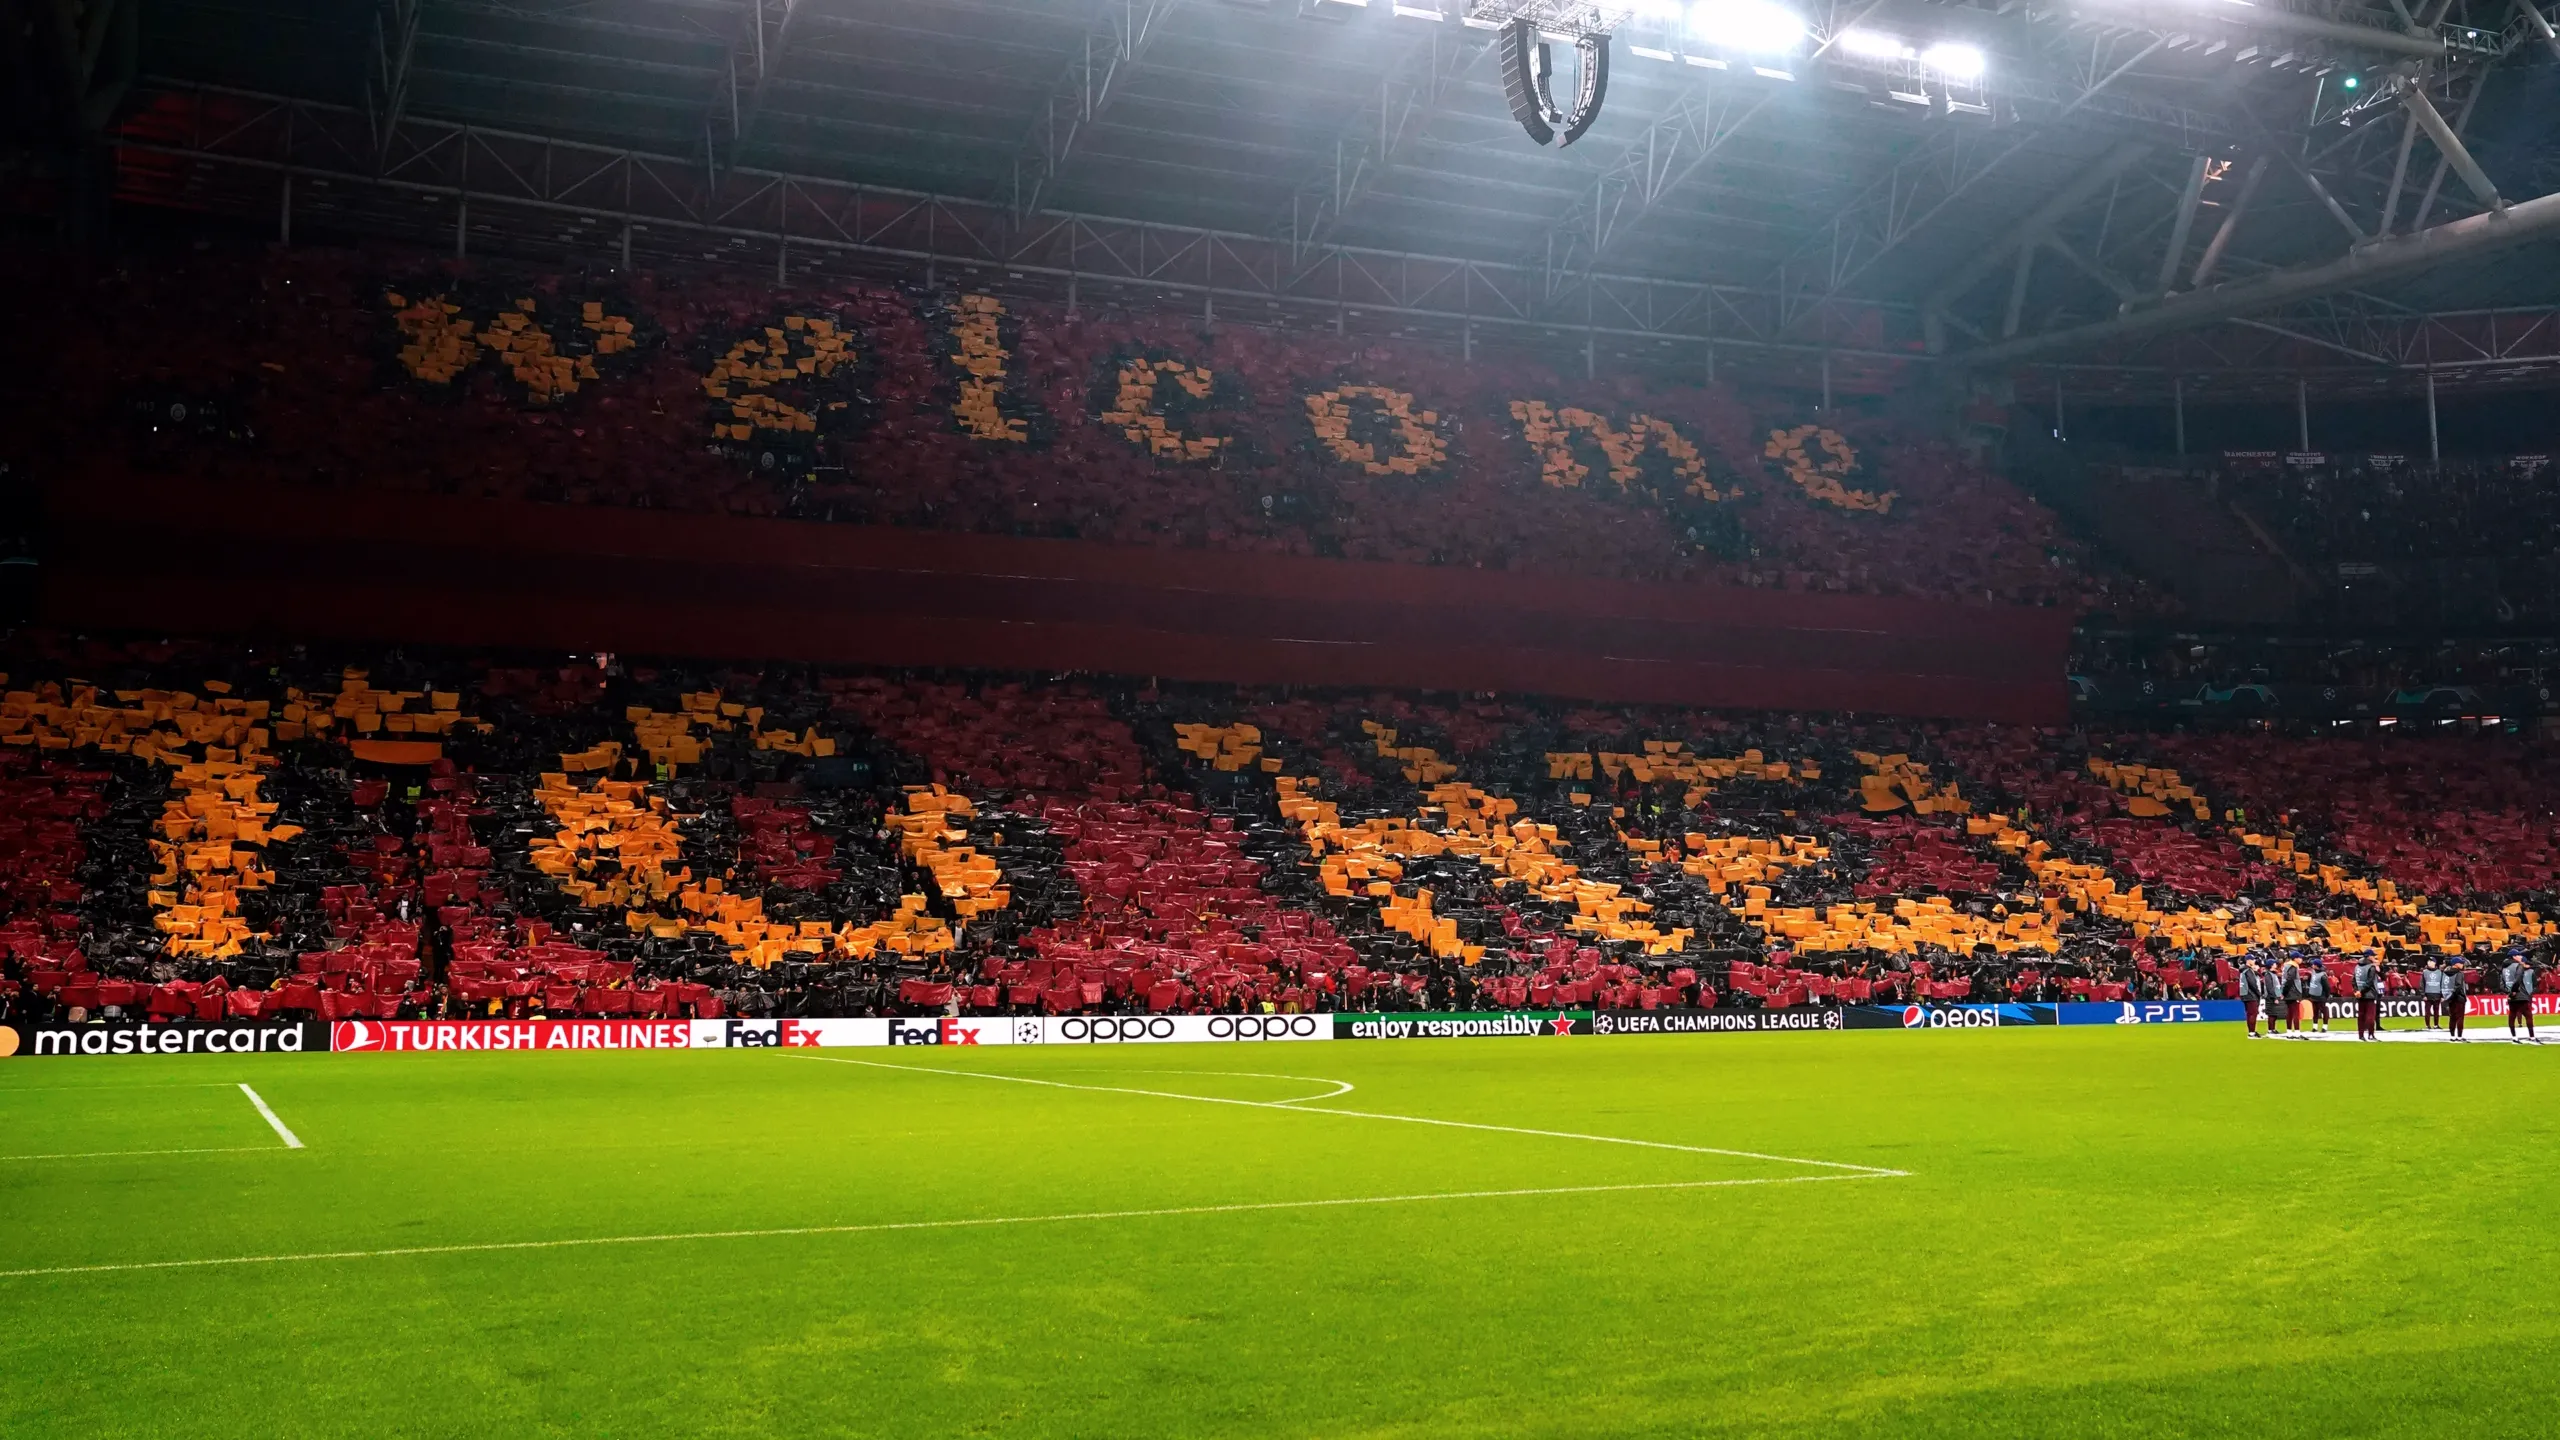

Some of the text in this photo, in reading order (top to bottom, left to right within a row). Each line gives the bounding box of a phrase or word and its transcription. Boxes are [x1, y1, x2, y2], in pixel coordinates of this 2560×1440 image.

[1617, 1013, 1820, 1032] UEFA CHAMPIONS LEAGUE
[1930, 1004, 1999, 1028] pepsi
[2145, 1005, 2201, 1022] PS5
[35, 1022, 303, 1055] mastercard
[390, 1023, 689, 1050] TURKISH AIRLINES
[726, 1019, 823, 1047] FedEx
[888, 1018, 980, 1045] FedEx
[1061, 1018, 1175, 1043] oppo
[1208, 1016, 1316, 1041] oppo
[1352, 1015, 1543, 1039] enjoy responsibly
